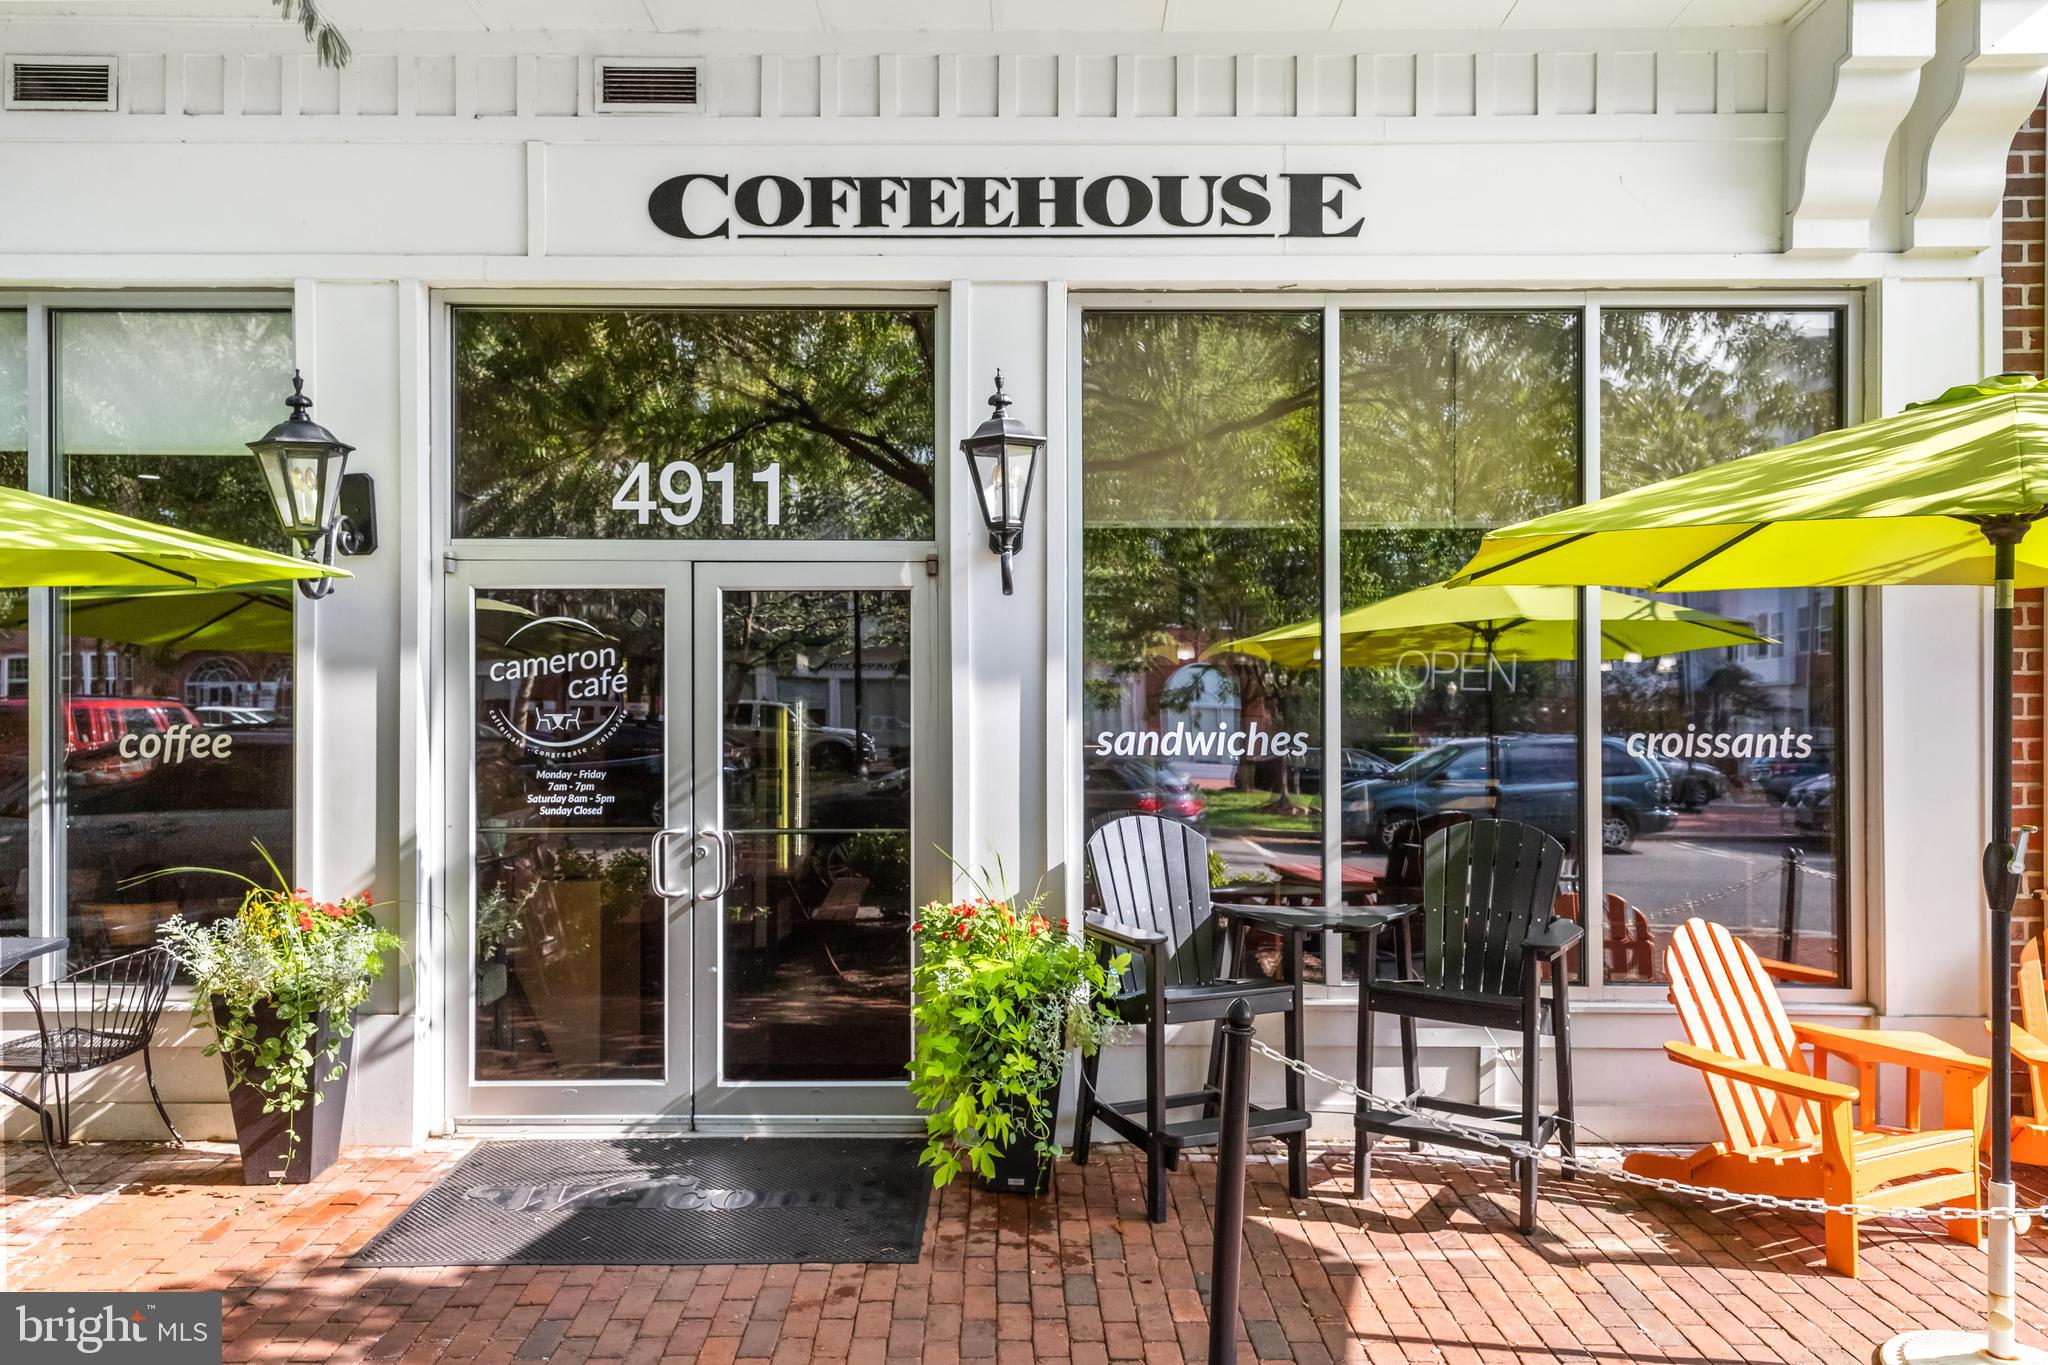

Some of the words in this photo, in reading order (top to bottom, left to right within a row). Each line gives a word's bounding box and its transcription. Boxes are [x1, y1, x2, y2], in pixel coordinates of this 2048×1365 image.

[648, 173, 1364, 239] COFFEEHOUSE
[612, 461, 780, 526] 4911
[489, 647, 616, 682] cameron
[1395, 650, 1518, 693] OPEN
[568, 667, 628, 699] café
[119, 724, 233, 763] coffee
[489, 709, 526, 748] caffeinate
[534, 748, 587, 759] congregate
[596, 709, 628, 746] celebrate
[1095, 722, 1309, 757] sandwiches
[1626, 724, 1813, 759] croissants
[536, 769, 573, 780] Monday
[579, 769, 607, 780] Friday
[547, 782, 568, 791] 7am
[575, 782, 595, 792] 7pm
[527, 794, 567, 805] Saturday
[568, 794, 588, 803] 8am
[595, 794, 616, 804] 5pm
[539, 806, 573, 817] Sunday
[573, 806, 603, 815] Closed
